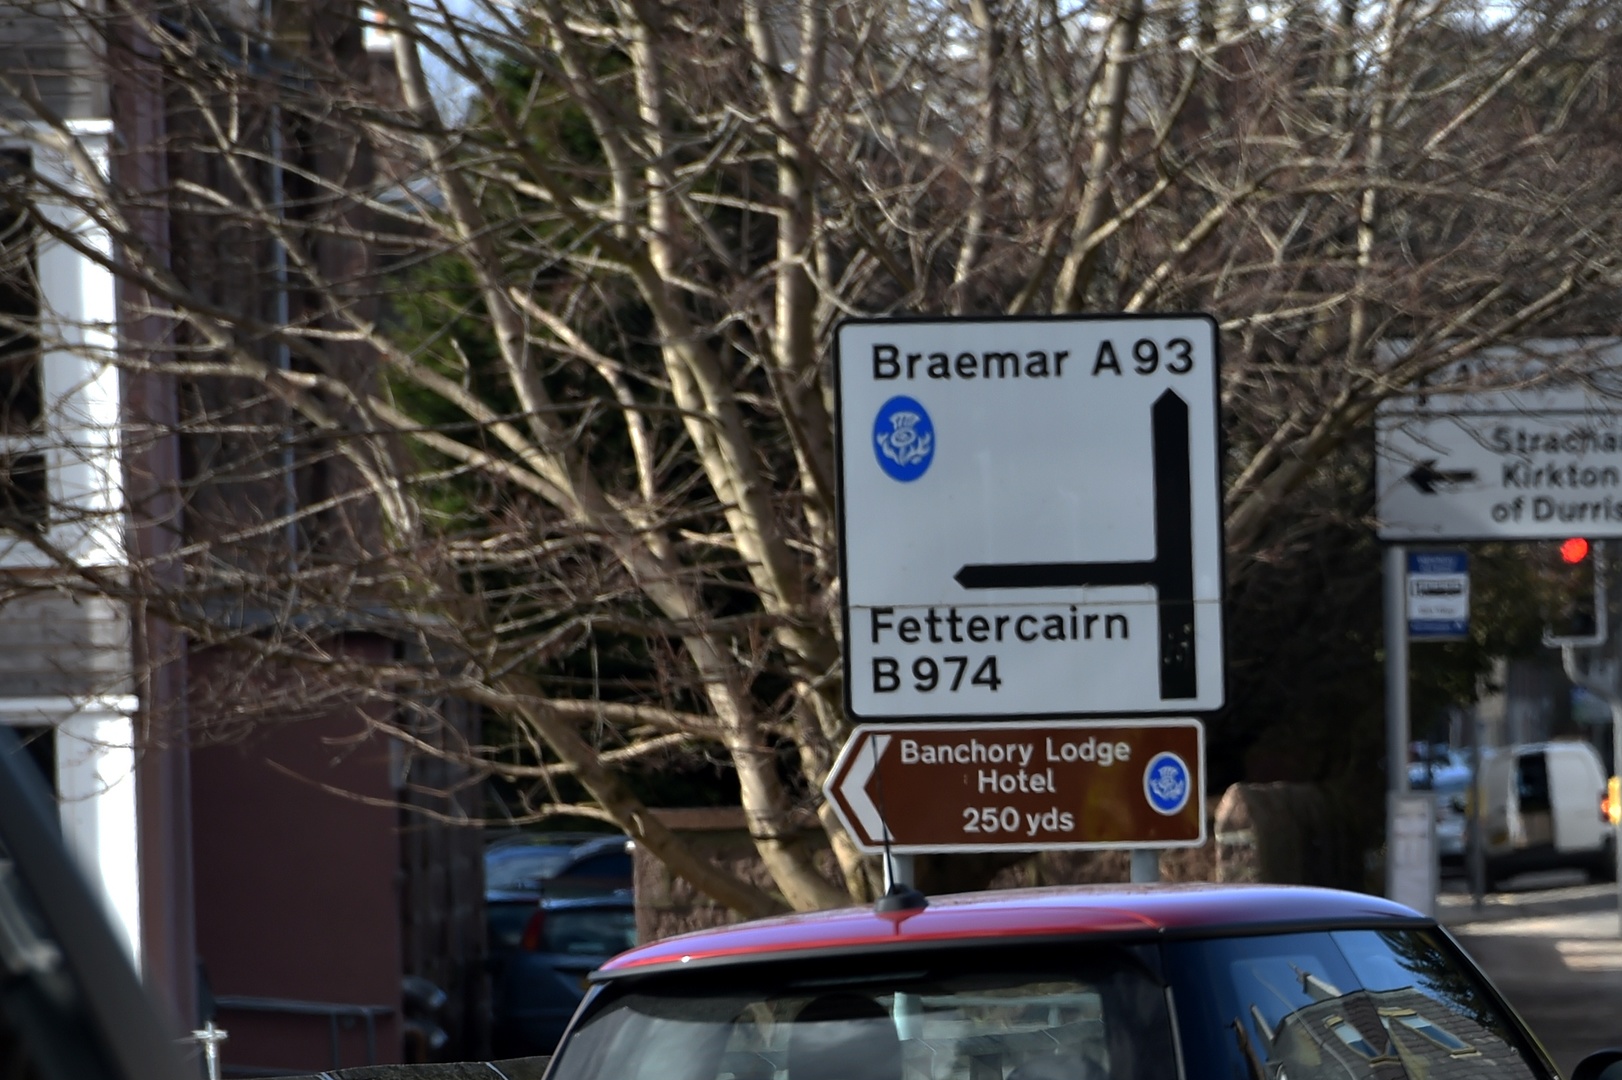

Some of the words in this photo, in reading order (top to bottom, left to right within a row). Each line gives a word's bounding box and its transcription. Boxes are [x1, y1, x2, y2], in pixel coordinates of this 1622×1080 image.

[871, 343, 1070, 381] Braemar
[1091, 337, 1194, 378] A93
[1500, 463, 1620, 489] Kirkton
[1490, 496, 1526, 524] of
[870, 605, 1129, 645] Fettercairn
[871, 655, 1002, 694] B974
[901, 739, 1033, 767] Banchory
[1045, 736, 1131, 768] Lodge
[977, 767, 1056, 794] Hotel
[962, 807, 1020, 833] 250
[1025, 807, 1075, 837] yds
